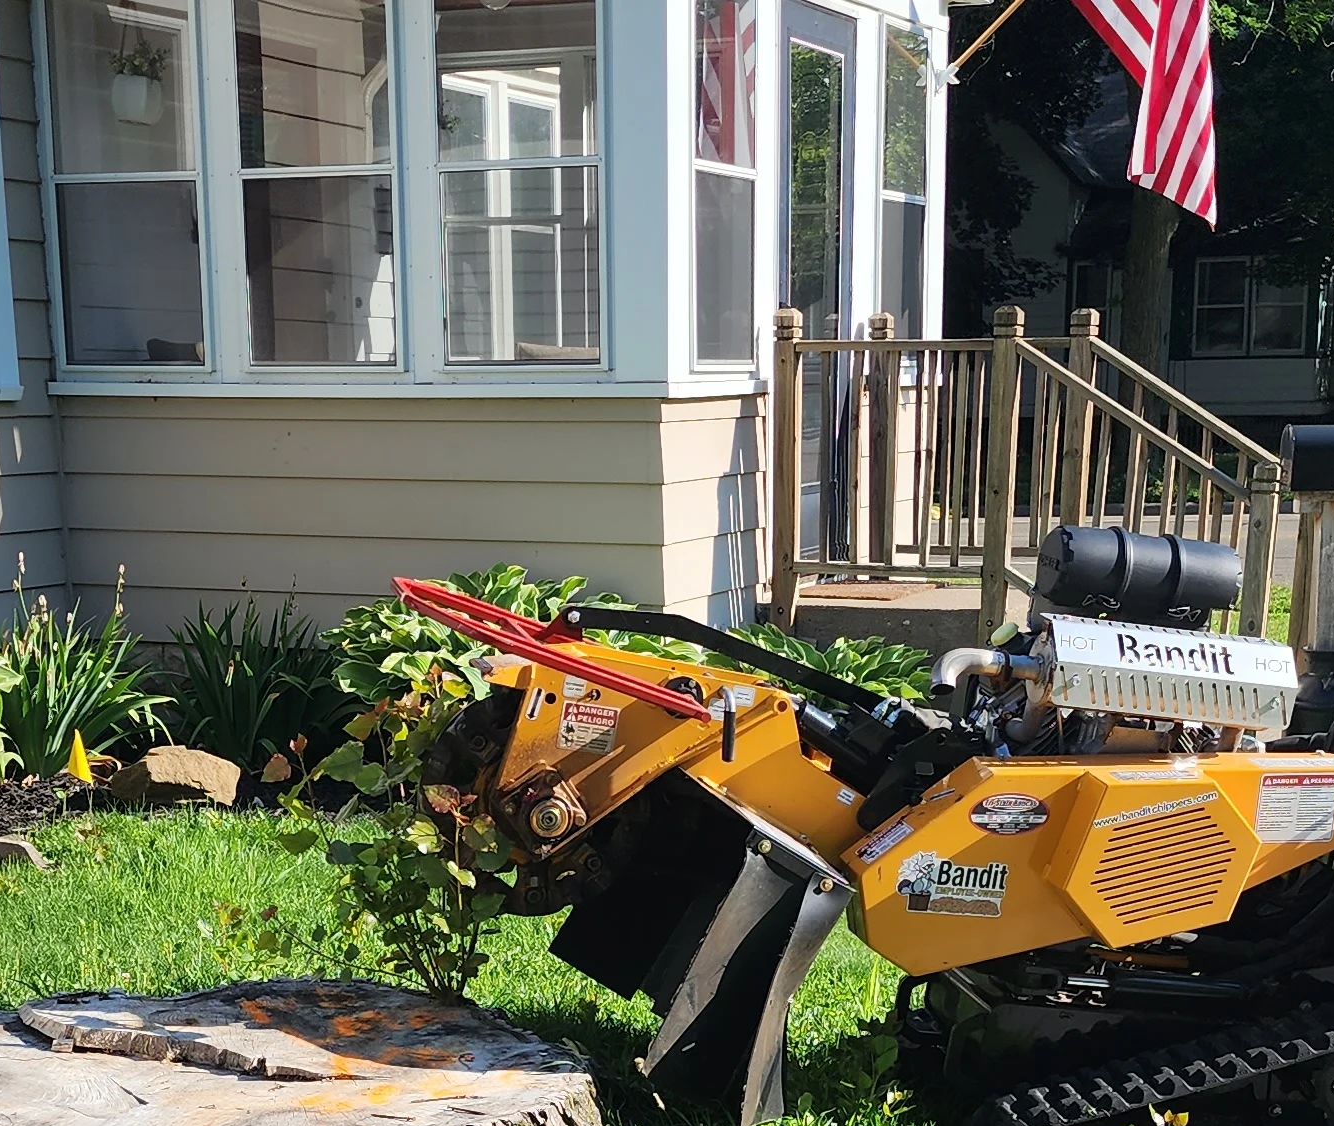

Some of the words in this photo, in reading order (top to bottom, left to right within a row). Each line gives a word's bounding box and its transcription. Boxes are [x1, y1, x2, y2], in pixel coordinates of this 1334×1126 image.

[1060, 634, 1097, 651] HOT
[1116, 633, 1236, 676] Bandit
[1255, 657, 1292, 674] HOT
[578, 705, 615, 717] DANGER
[577, 714, 615, 727] PELIGRO
[1272, 777, 1299, 785] DANGER
[1093, 791, 1218, 828] www.banditchippers.com
[936, 860, 1008, 890] Bandit
